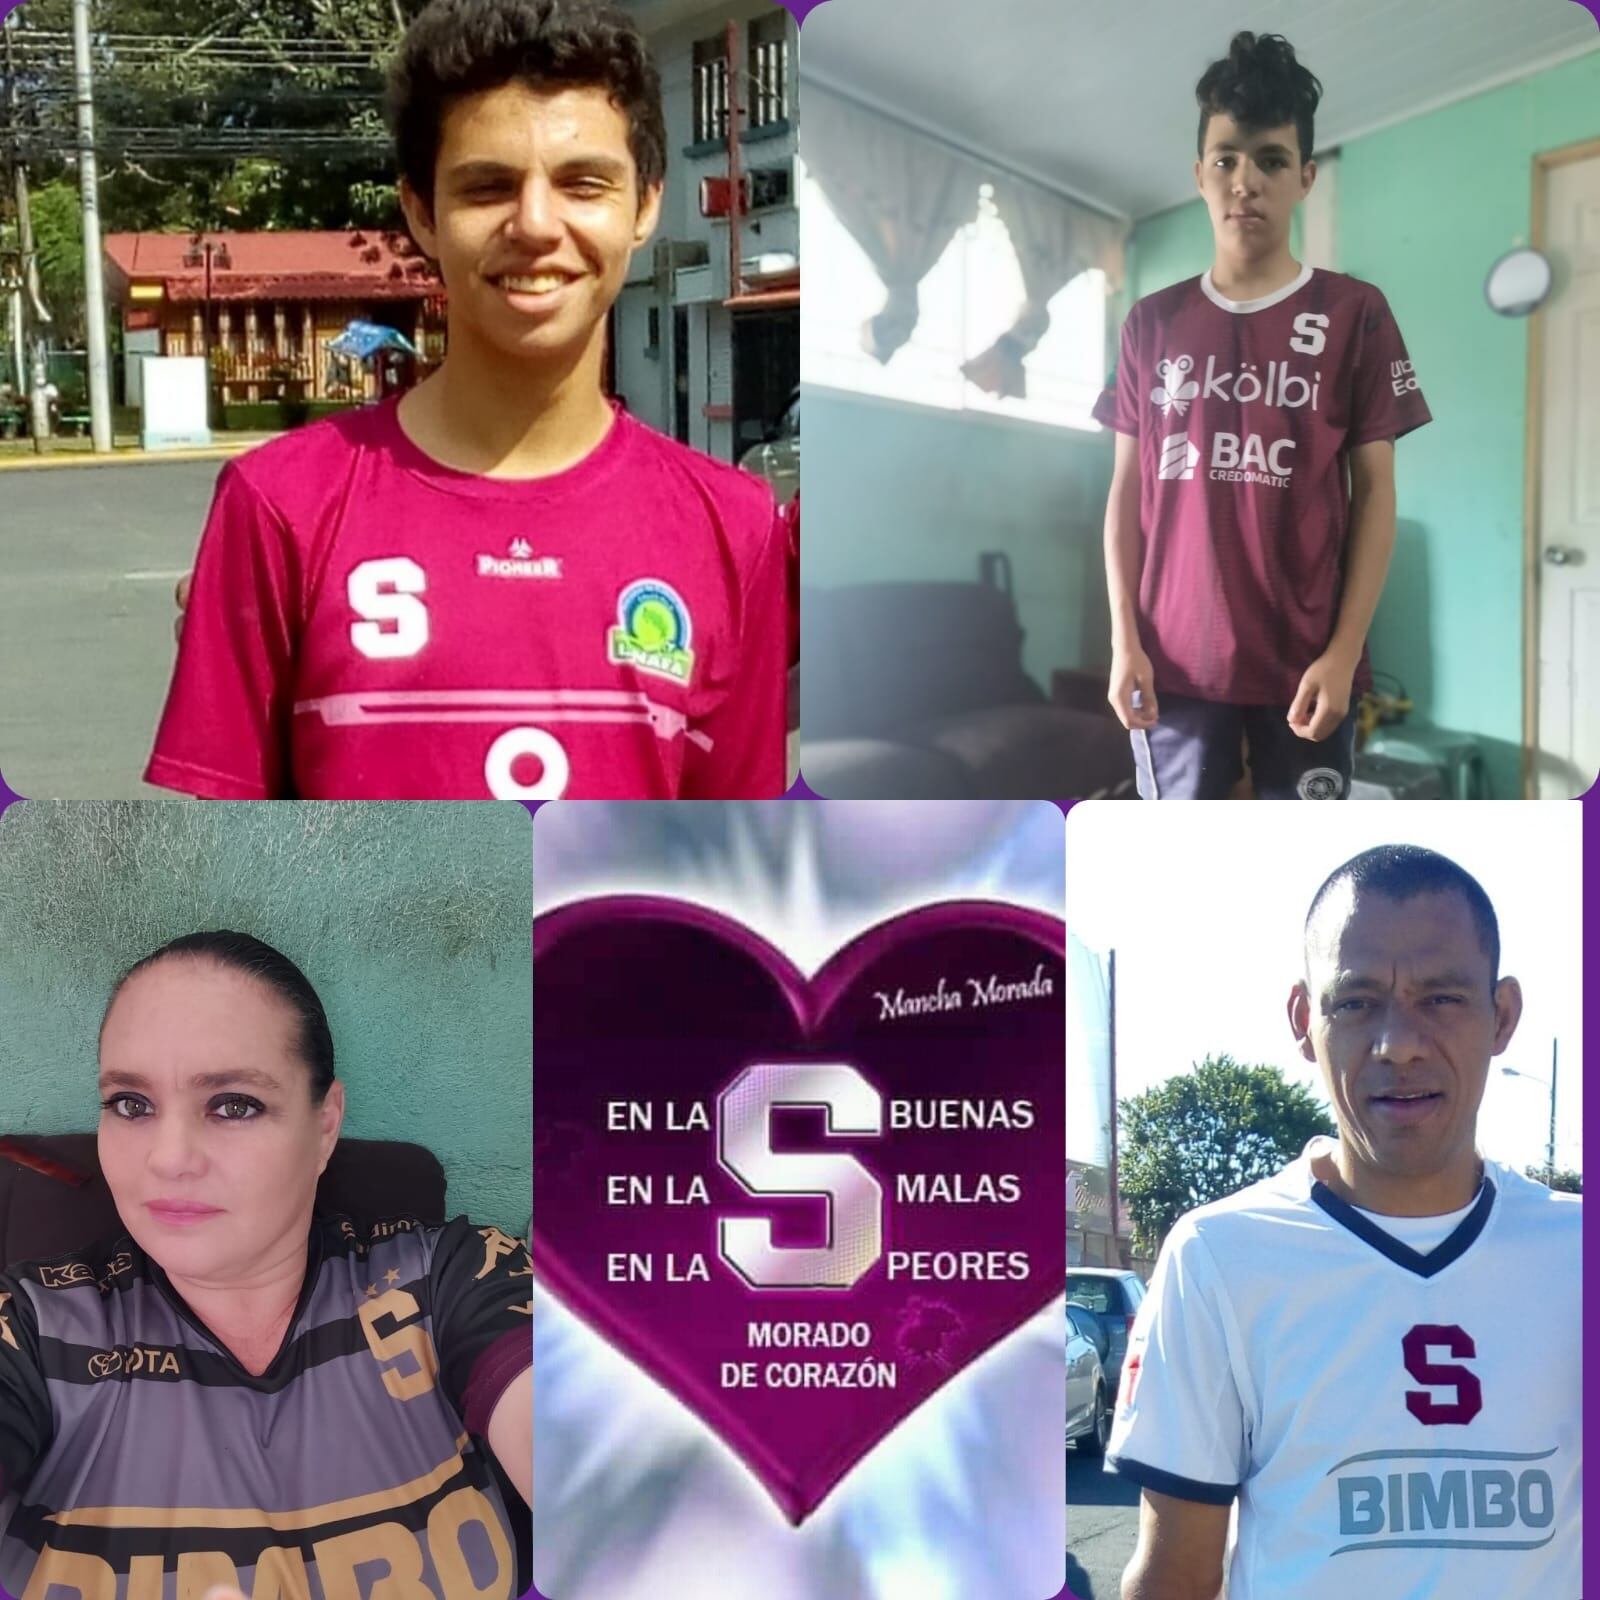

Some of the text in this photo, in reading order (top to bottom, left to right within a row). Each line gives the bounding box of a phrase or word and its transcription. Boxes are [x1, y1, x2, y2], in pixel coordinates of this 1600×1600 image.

[1289, 313, 1330, 356] S
[1202, 354, 1321, 411] kölbi
[1210, 431, 1297, 477] BAC
[1209, 468, 1291, 488] CREDOMATIC
[347, 557, 429, 659] S
[873, 964, 1053, 1020] Mancha Morada
[608, 1100, 1034, 1131] EN LA BUENAS
[608, 1174, 1021, 1205] EN LA MALAS
[716, 1063, 883, 1291] S
[608, 1251, 1030, 1283] EN LA PEORES
[358, 1287, 438, 1401] S
[747, 1321, 870, 1348] MORADO
[720, 1356, 896, 1388] DE CORAZÓN
[1401, 1324, 1482, 1426] S
[1337, 1468, 1554, 1536] BIMBO
